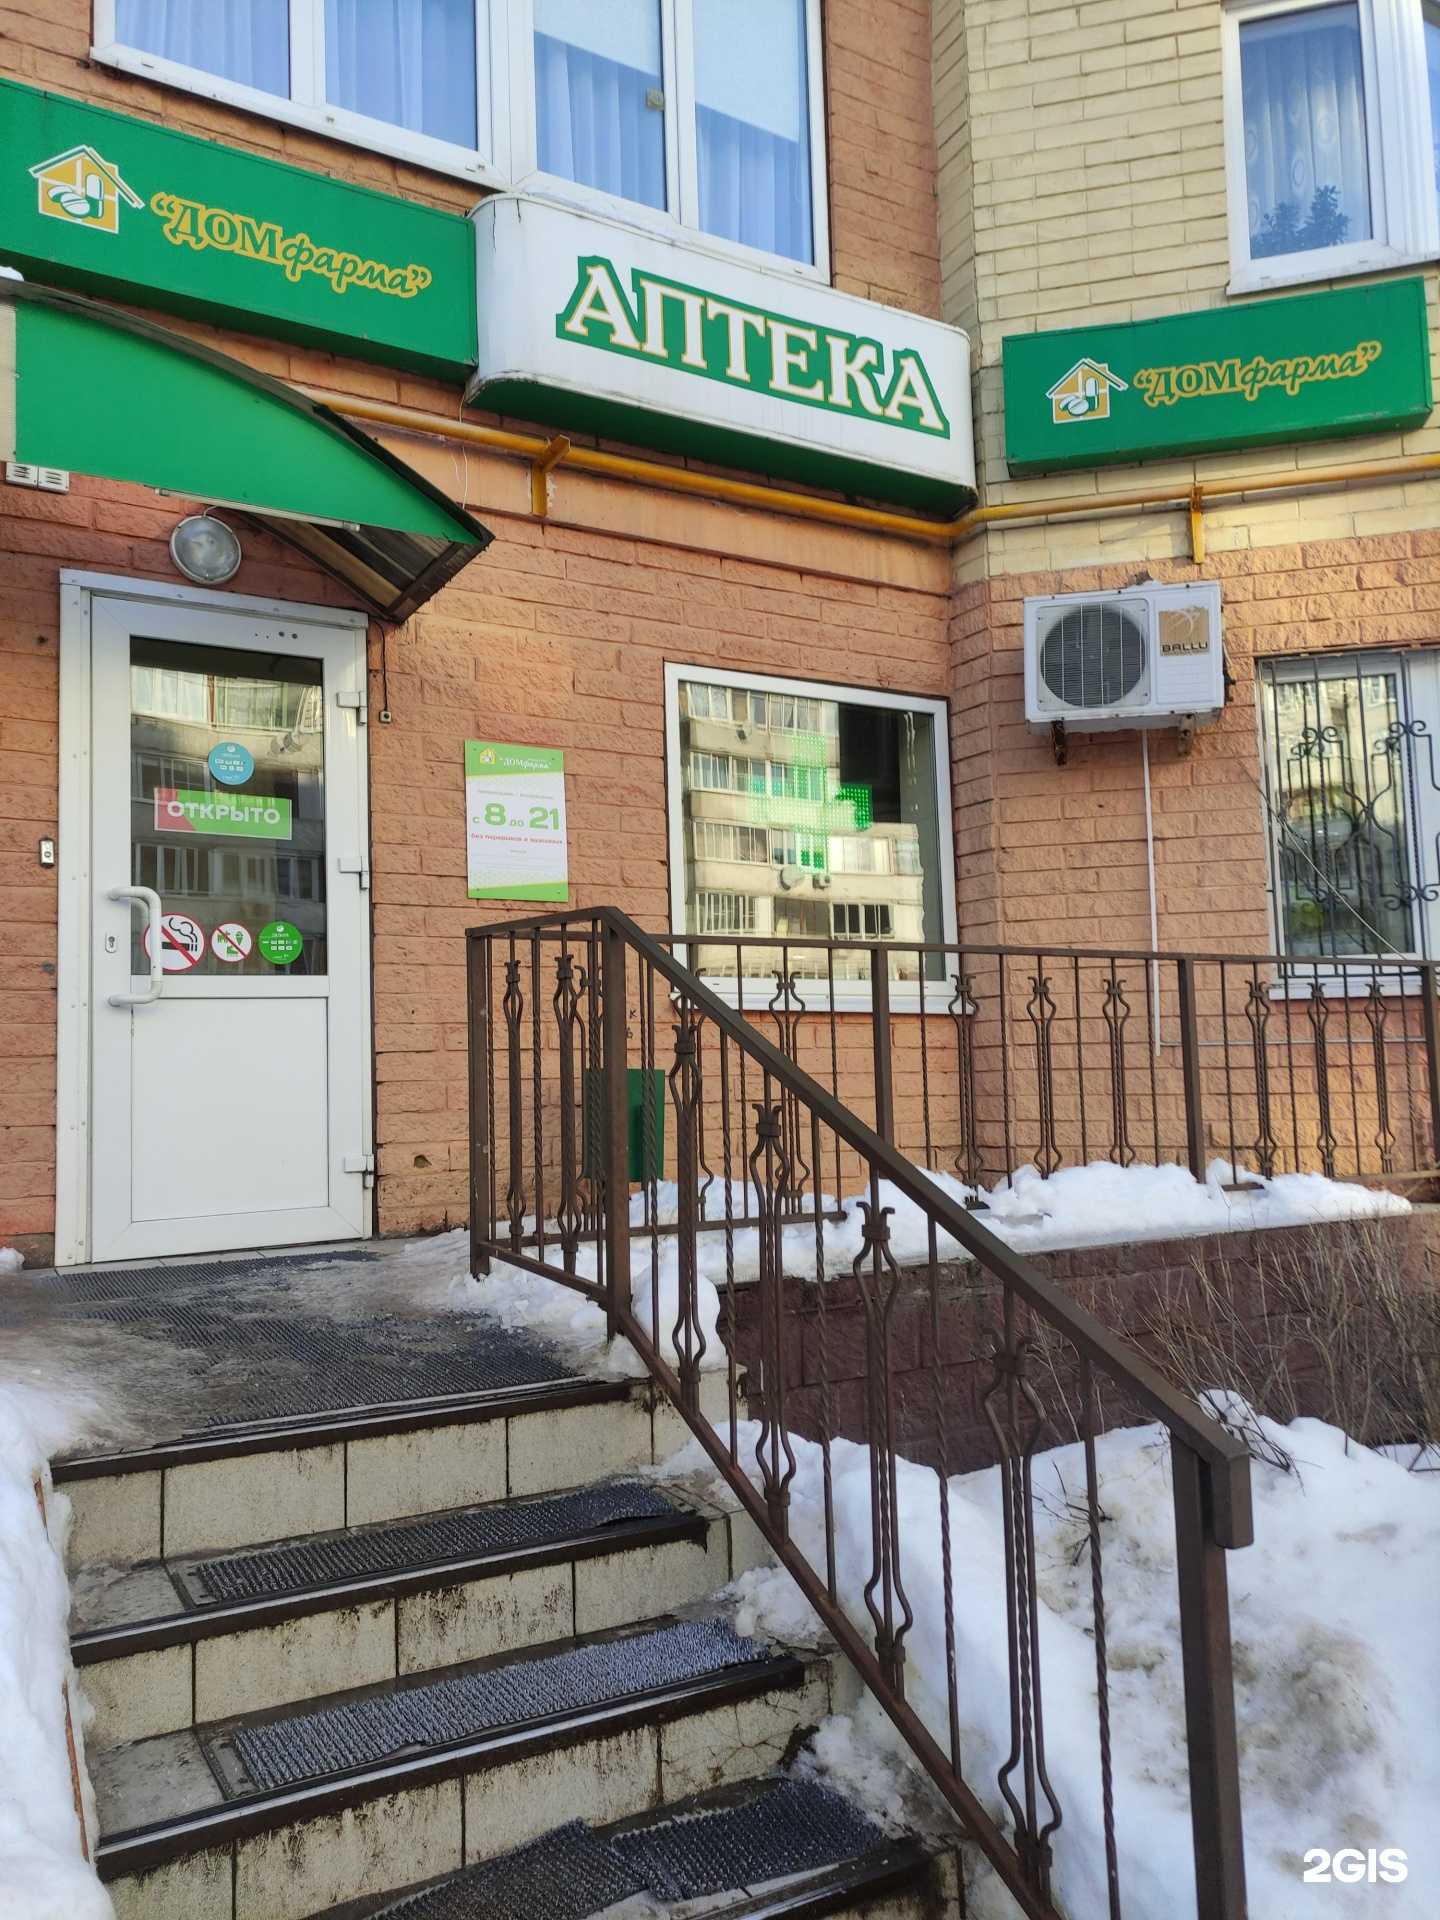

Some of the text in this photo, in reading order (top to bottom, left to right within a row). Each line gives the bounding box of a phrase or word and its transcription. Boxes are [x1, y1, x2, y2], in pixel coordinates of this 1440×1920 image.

[558, 257, 949, 438] АПТЕКА
[167, 801, 281, 824] ОТКРЫТО
[484, 803, 506, 826] 8
[529, 807, 560, 830] 21
